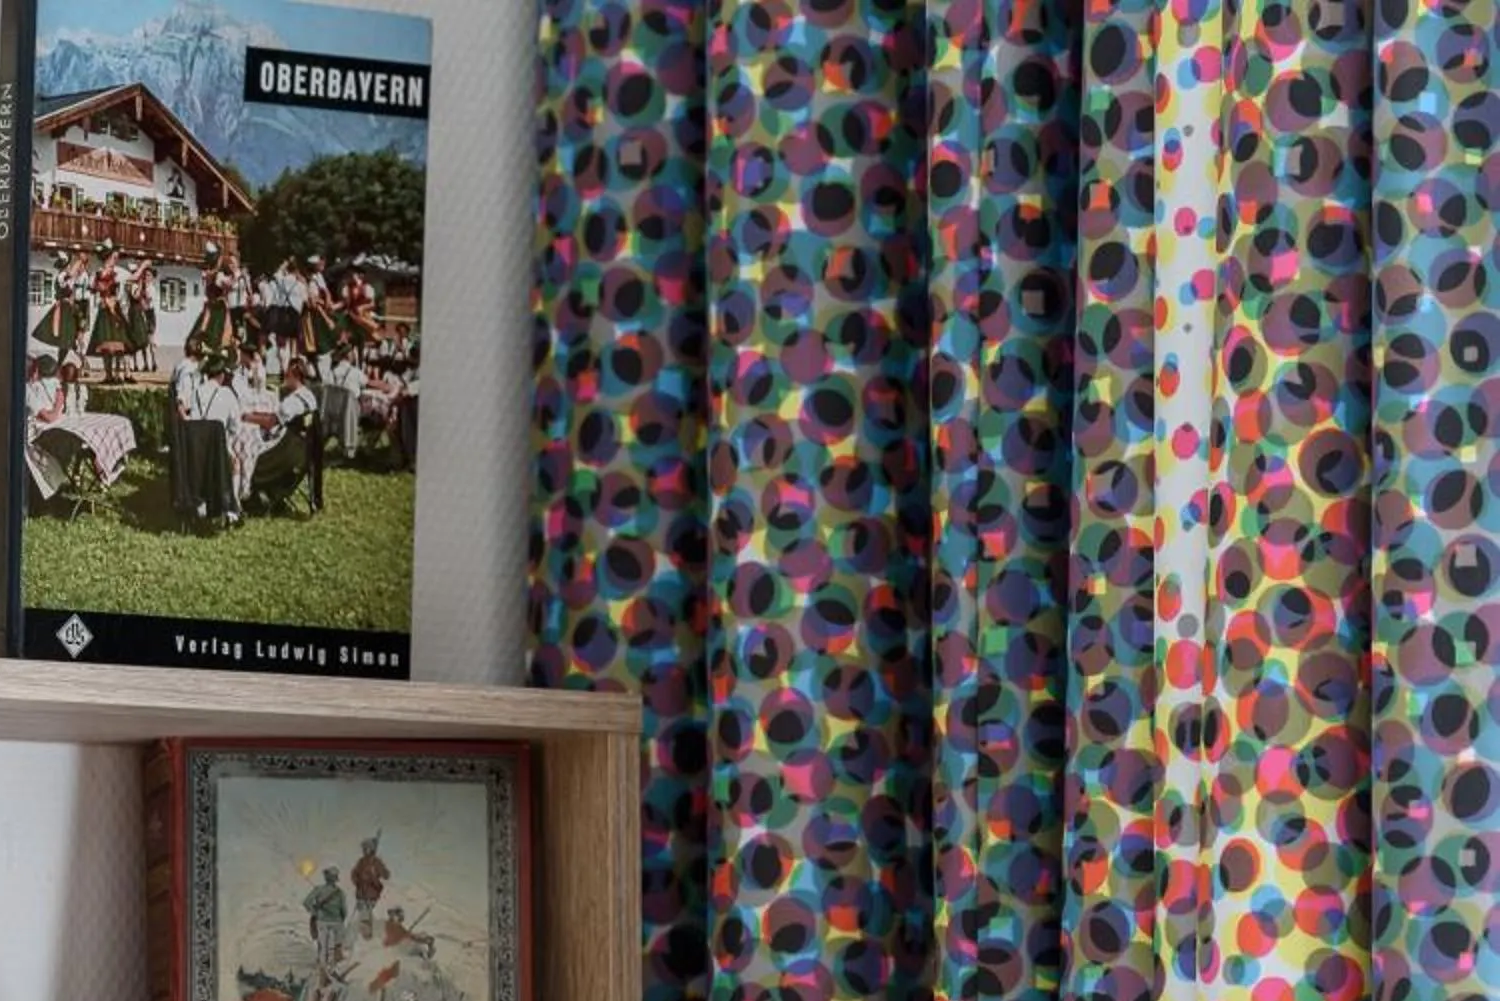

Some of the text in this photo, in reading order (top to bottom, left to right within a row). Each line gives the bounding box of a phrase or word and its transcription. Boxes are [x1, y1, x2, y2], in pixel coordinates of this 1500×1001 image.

[259, 60, 424, 107] OBERBAYERN
[175, 634, 400, 667] Verlag Ludwig Simon
